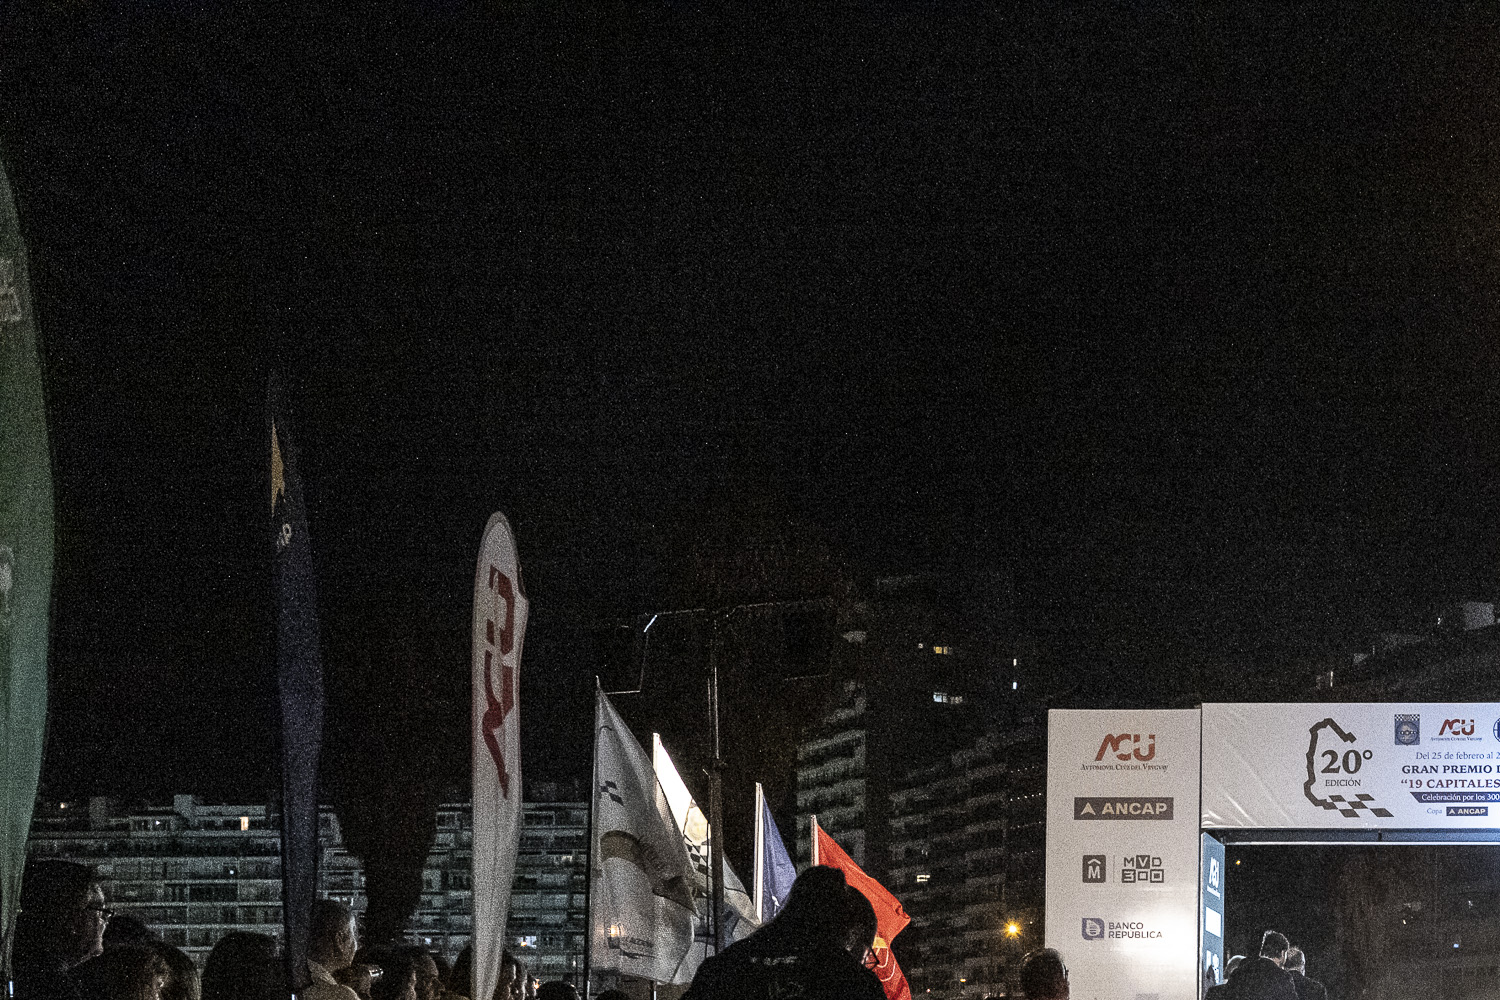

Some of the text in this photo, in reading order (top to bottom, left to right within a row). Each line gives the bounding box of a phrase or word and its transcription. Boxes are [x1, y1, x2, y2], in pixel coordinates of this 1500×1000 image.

[1438, 718, 1475, 736] ACU
[1095, 733, 1156, 762] ACU
[1415, 751, 1430, 760] Del
[1431, 751, 1442, 760] 25
[1444, 751, 1454, 760] de
[1456, 751, 1485, 760] febrero
[1486, 751, 1494, 760] al
[1495, 751, 1500, 760] 2
[1401, 765, 1439, 774] GRAN
[1442, 765, 1493, 774] PREMIO
[1325, 777, 1361, 787] EDICIÓN
[1421, 793, 1461, 801] Celebración
[1462, 794, 1474, 803] por
[1475, 792, 1486, 801] los
[1487, 793, 1500, 801] 300
[1101, 802, 1168, 815] ANCAP
[1123, 854, 1163, 869] MVD
[1121, 869, 1164, 884] 300
[1108, 921, 1144, 930] BANCO
